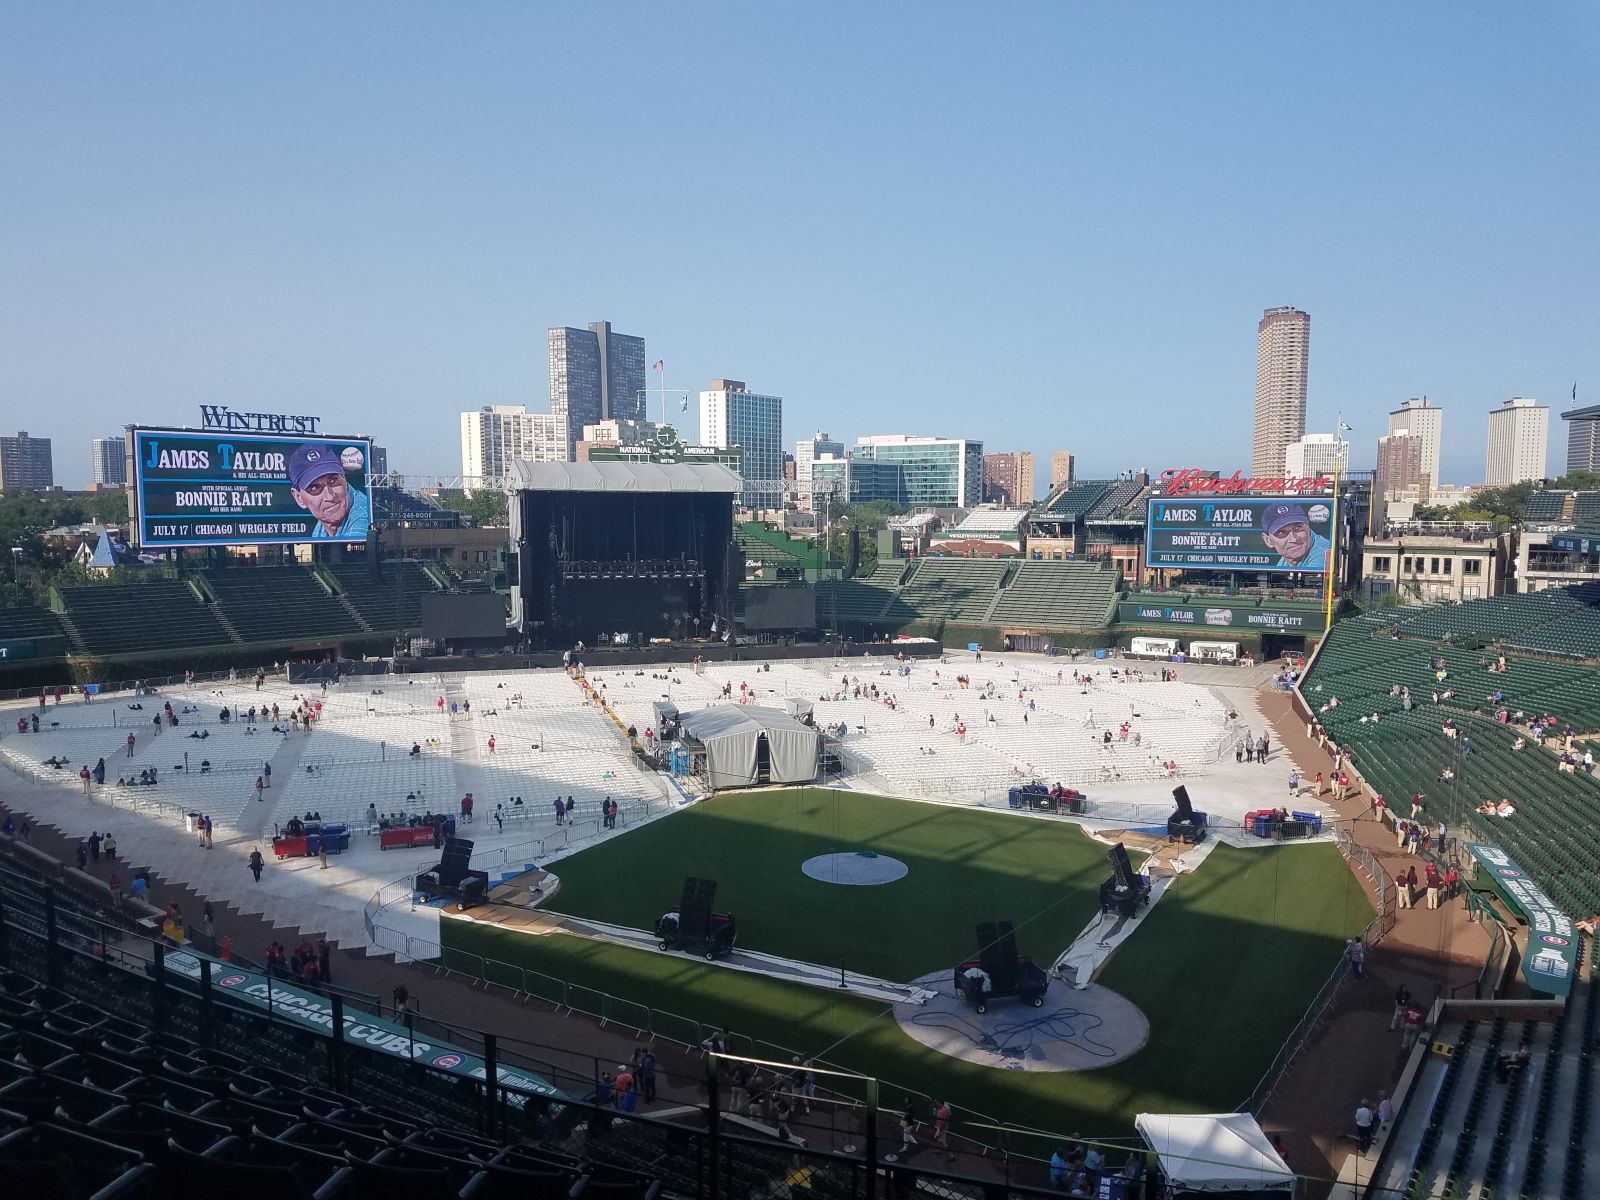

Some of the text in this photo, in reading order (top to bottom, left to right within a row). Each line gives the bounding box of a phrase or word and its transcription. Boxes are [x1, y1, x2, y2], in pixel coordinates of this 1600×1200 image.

[200, 405, 320, 433] WINTRUST
[147, 441, 286, 471] JAMES TAYLOR
[619, 446, 651, 454] NATIONAL
[683, 447, 715, 455] AMERICAN
[1160, 468, 1330, 495] Budweiser
[175, 491, 273, 506] BONNIE RAITT
[1156, 505, 1252, 522] JAMES TAYLOR
[153, 523, 307, 536] JULY 17 CHICAGO WRIGLEY FIELD
[1172, 535, 1240, 546] BONNIE RAITT
[1160, 554, 1176, 562] JULY
[1217, 555, 1248, 563] WRIGLEY
[1249, 556, 1269, 564] FIELD
[1137, 607, 1162, 617] JAMES
[1164, 607, 1194, 619] TAYLOR
[1248, 615, 1303, 625] BONNIE RAITT
[243, 984, 431, 1058] CHICAGO CUBS
